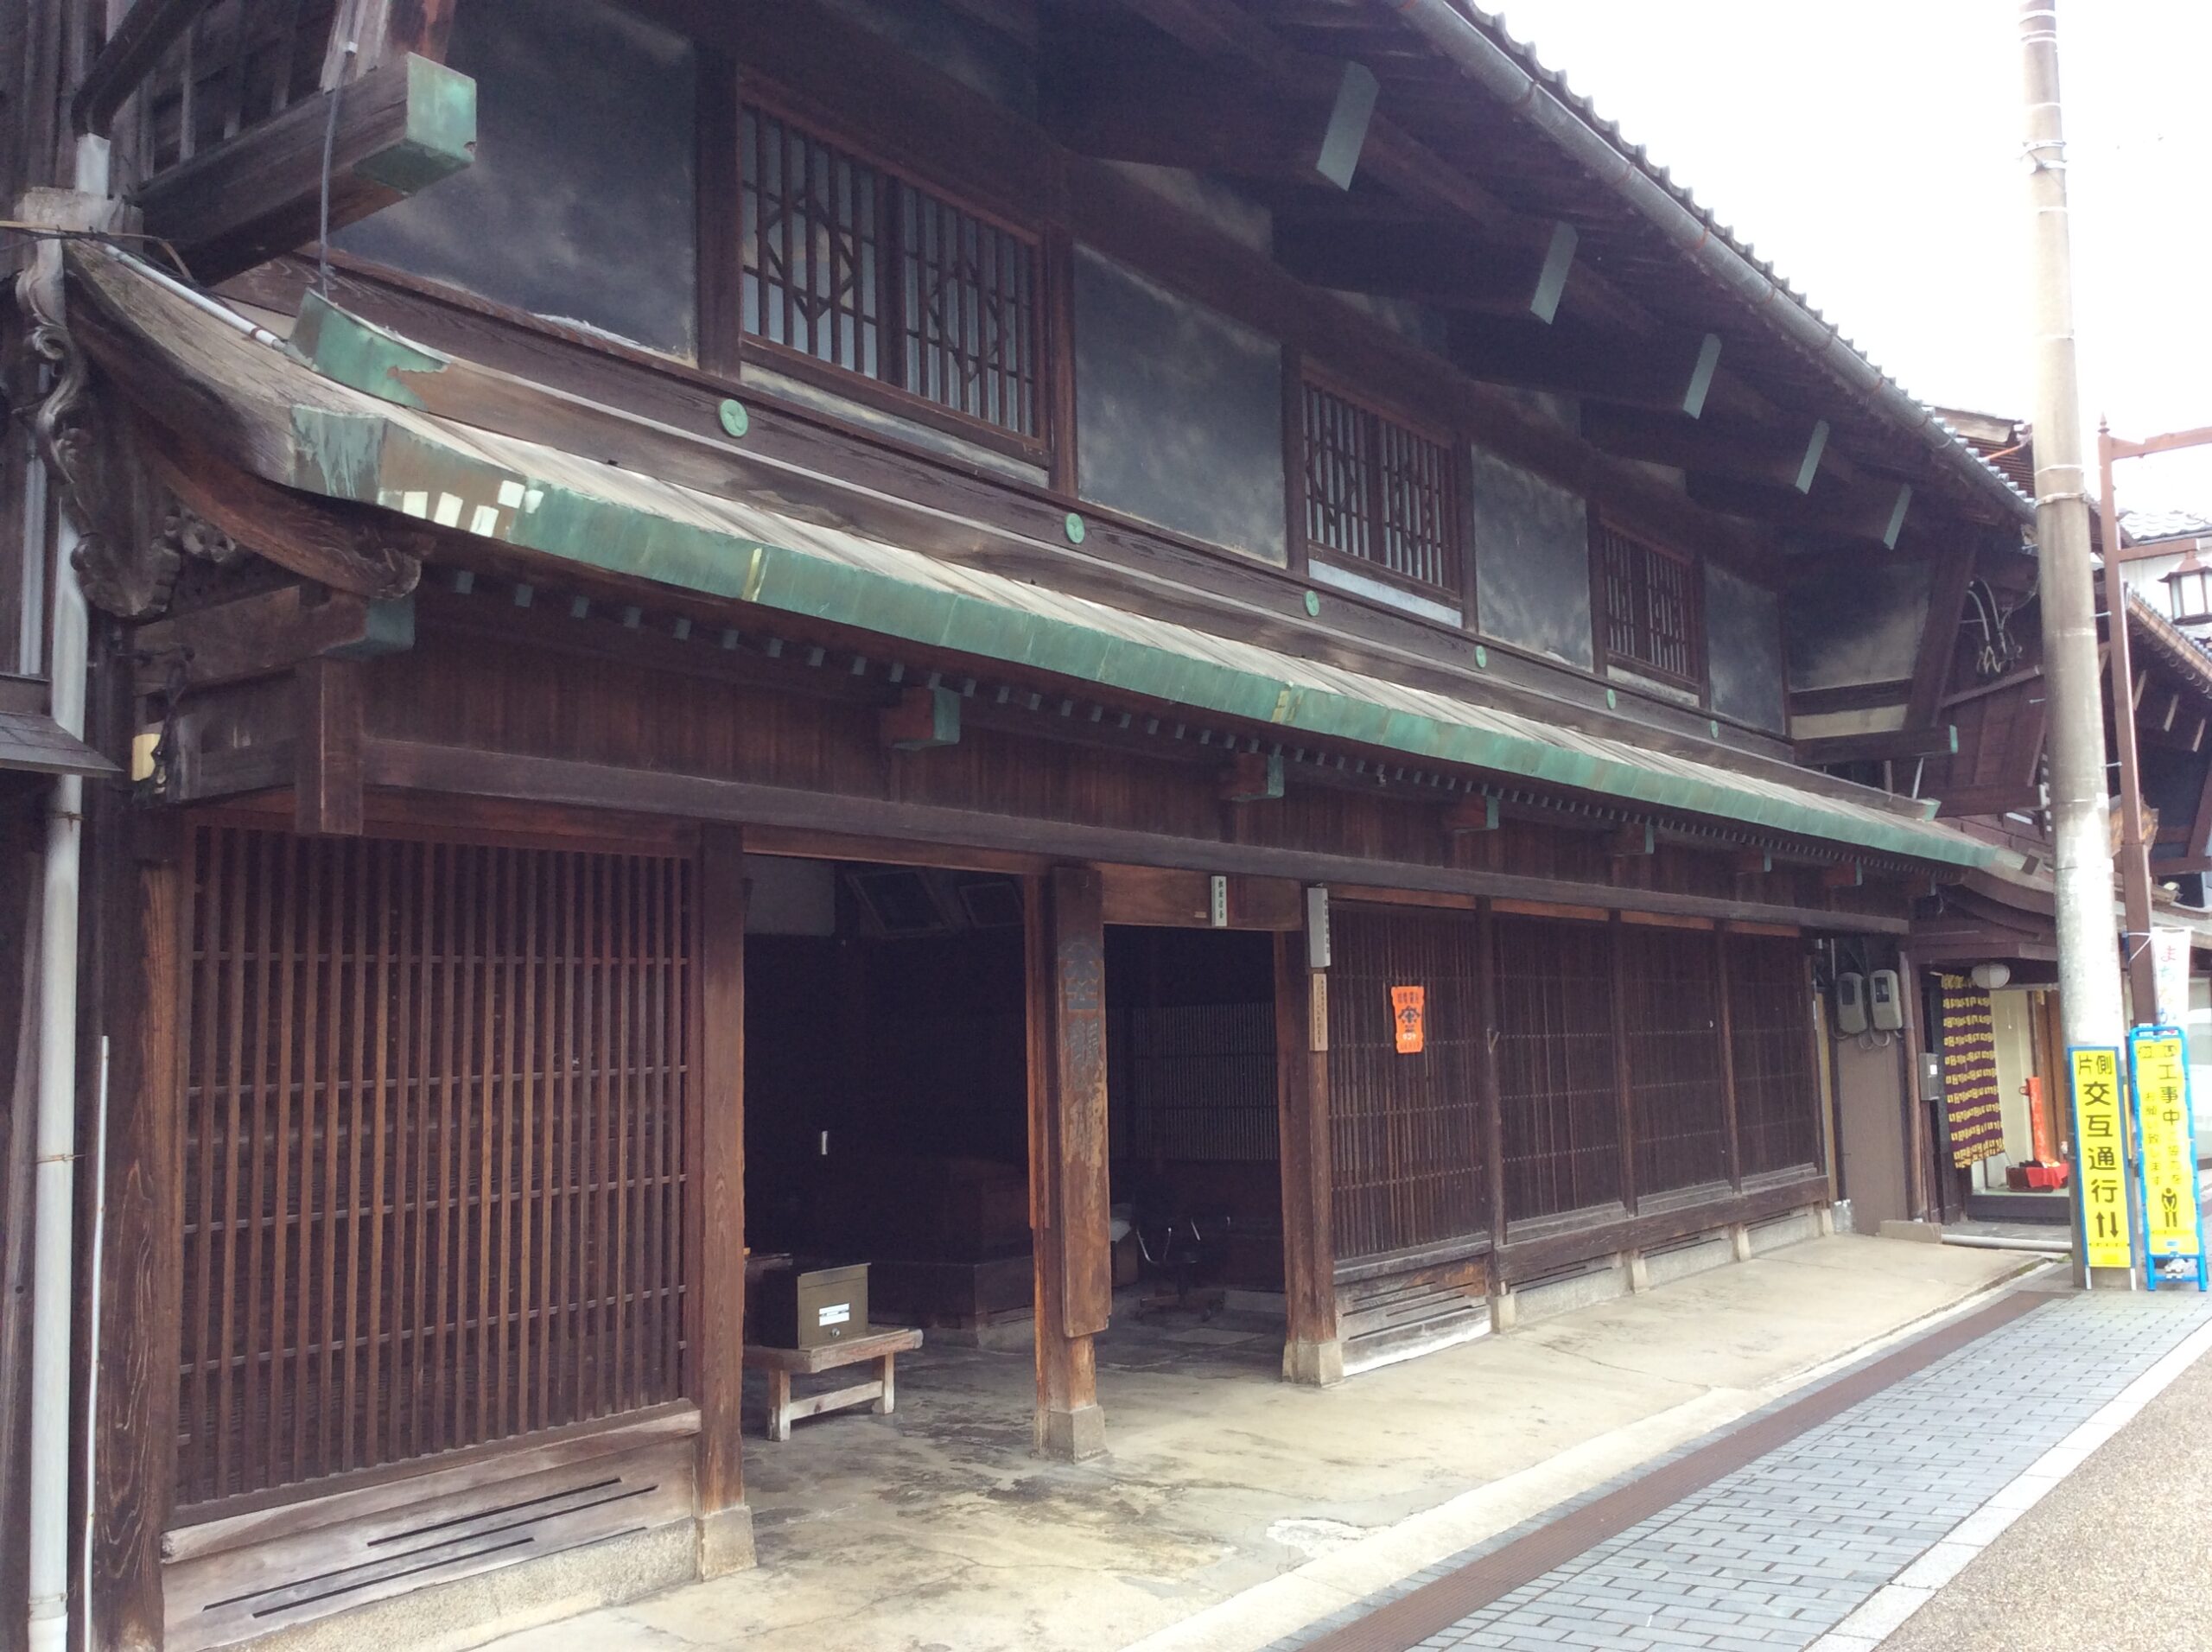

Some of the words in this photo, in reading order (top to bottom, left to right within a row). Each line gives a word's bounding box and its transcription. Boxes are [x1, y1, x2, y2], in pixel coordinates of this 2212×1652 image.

[2078, 1055, 2113, 1076] 片側
[2158, 1064, 2180, 1126] 工事中
[2083, 1081, 2119, 1204] 交互通行
